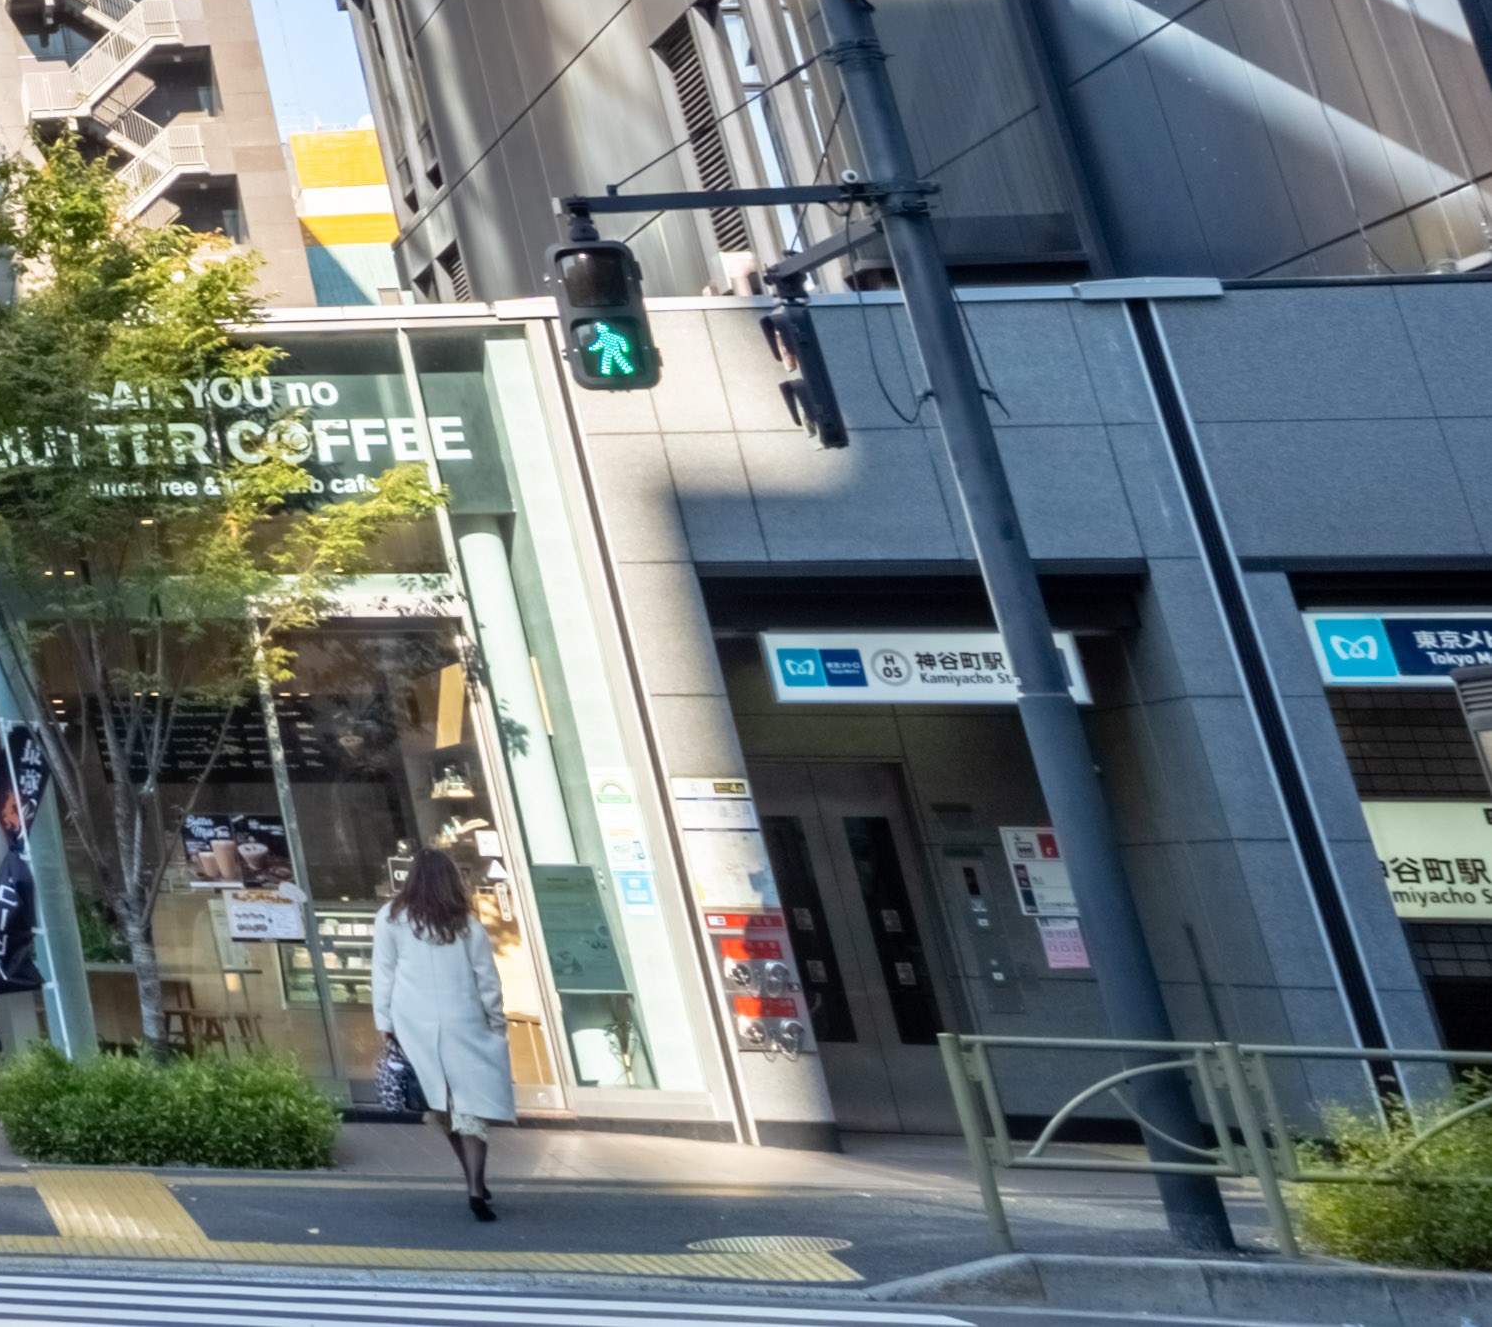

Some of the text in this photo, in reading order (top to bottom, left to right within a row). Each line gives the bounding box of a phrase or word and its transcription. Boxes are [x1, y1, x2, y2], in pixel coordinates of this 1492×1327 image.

[285, 380, 340, 408] no
[226, 416, 473, 465] COFFEE
[204, 475, 222, 496] &
[883, 655, 895, 666] H
[915, 651, 1006, 672] 神谷町駅
[1426, 651, 1475, 667] Tokyo
[883, 666, 903, 678] 05
[920, 672, 994, 687] Kamiyacho
[1391, 887, 1477, 908] miyacho
